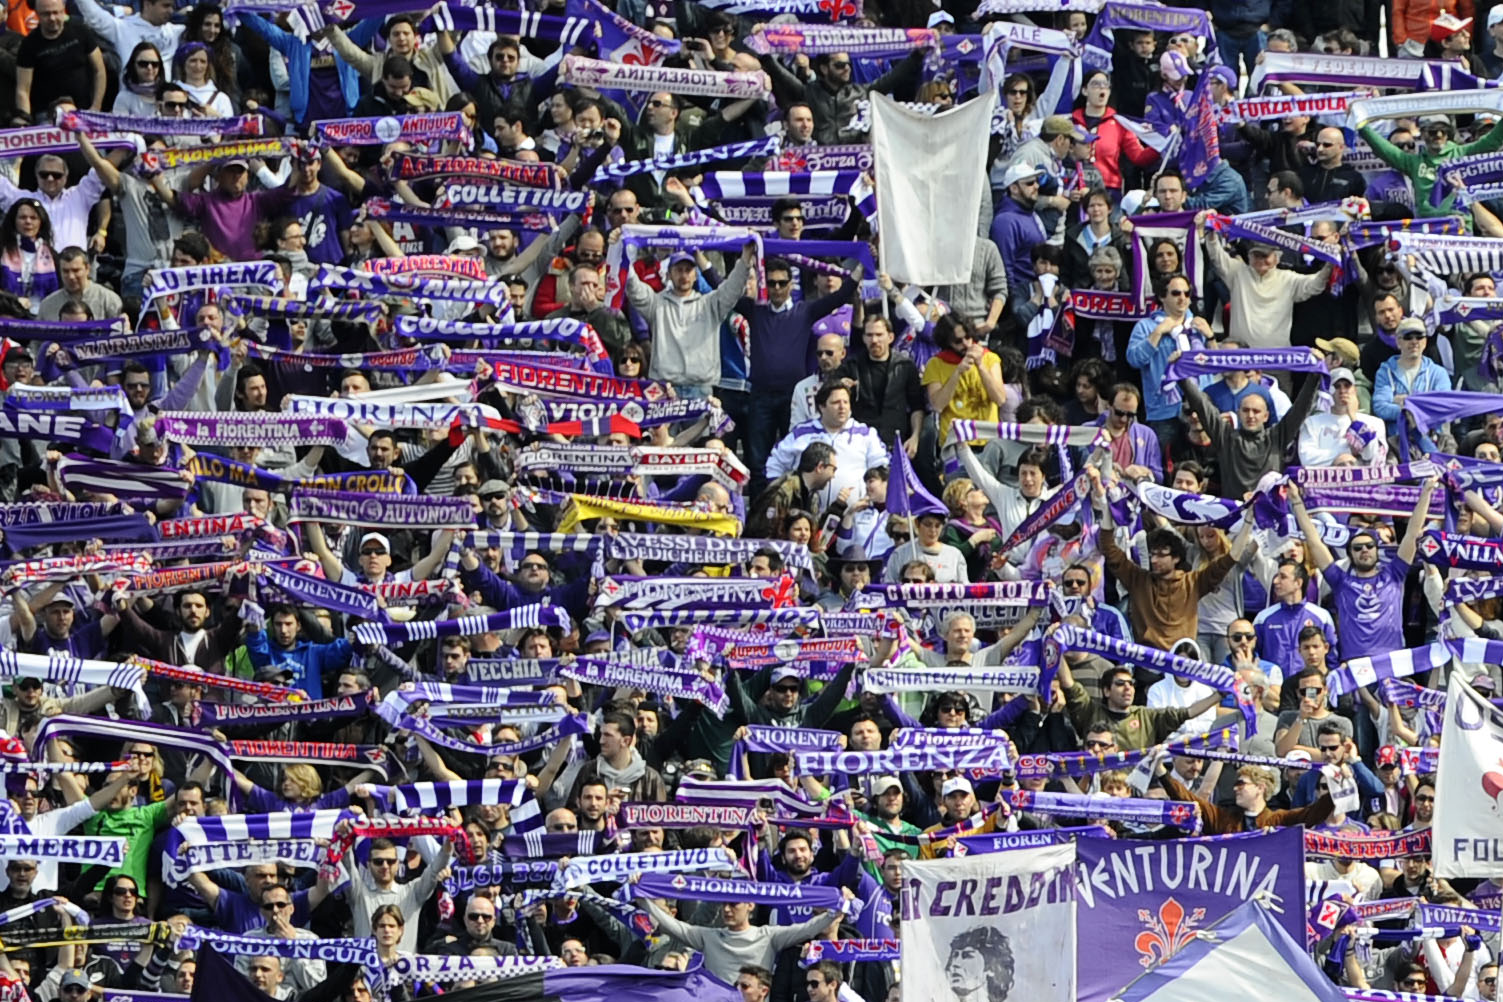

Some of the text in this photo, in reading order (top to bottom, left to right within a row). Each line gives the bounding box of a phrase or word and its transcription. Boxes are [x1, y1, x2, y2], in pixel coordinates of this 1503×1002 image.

[1238, 101, 1294, 117] FORZA
[450, 185, 585, 209] COLLETTIVO
[497, 364, 642, 400] FIORENTINA
[216, 423, 299, 438] FIORENTINA
[163, 516, 247, 538] ENTINA
[277, 570, 376, 610] FIORENTINA
[995, 583, 1047, 600] ROMA
[606, 666, 683, 685] FIORENTINA
[215, 698, 355, 718] FIORENTINA
[799, 749, 1008, 774] FIORENZA
[17, 839, 120, 862] MERDA
[588, 850, 708, 874] COLLETTIVO
[690, 880, 801, 898] FIORENTINA
